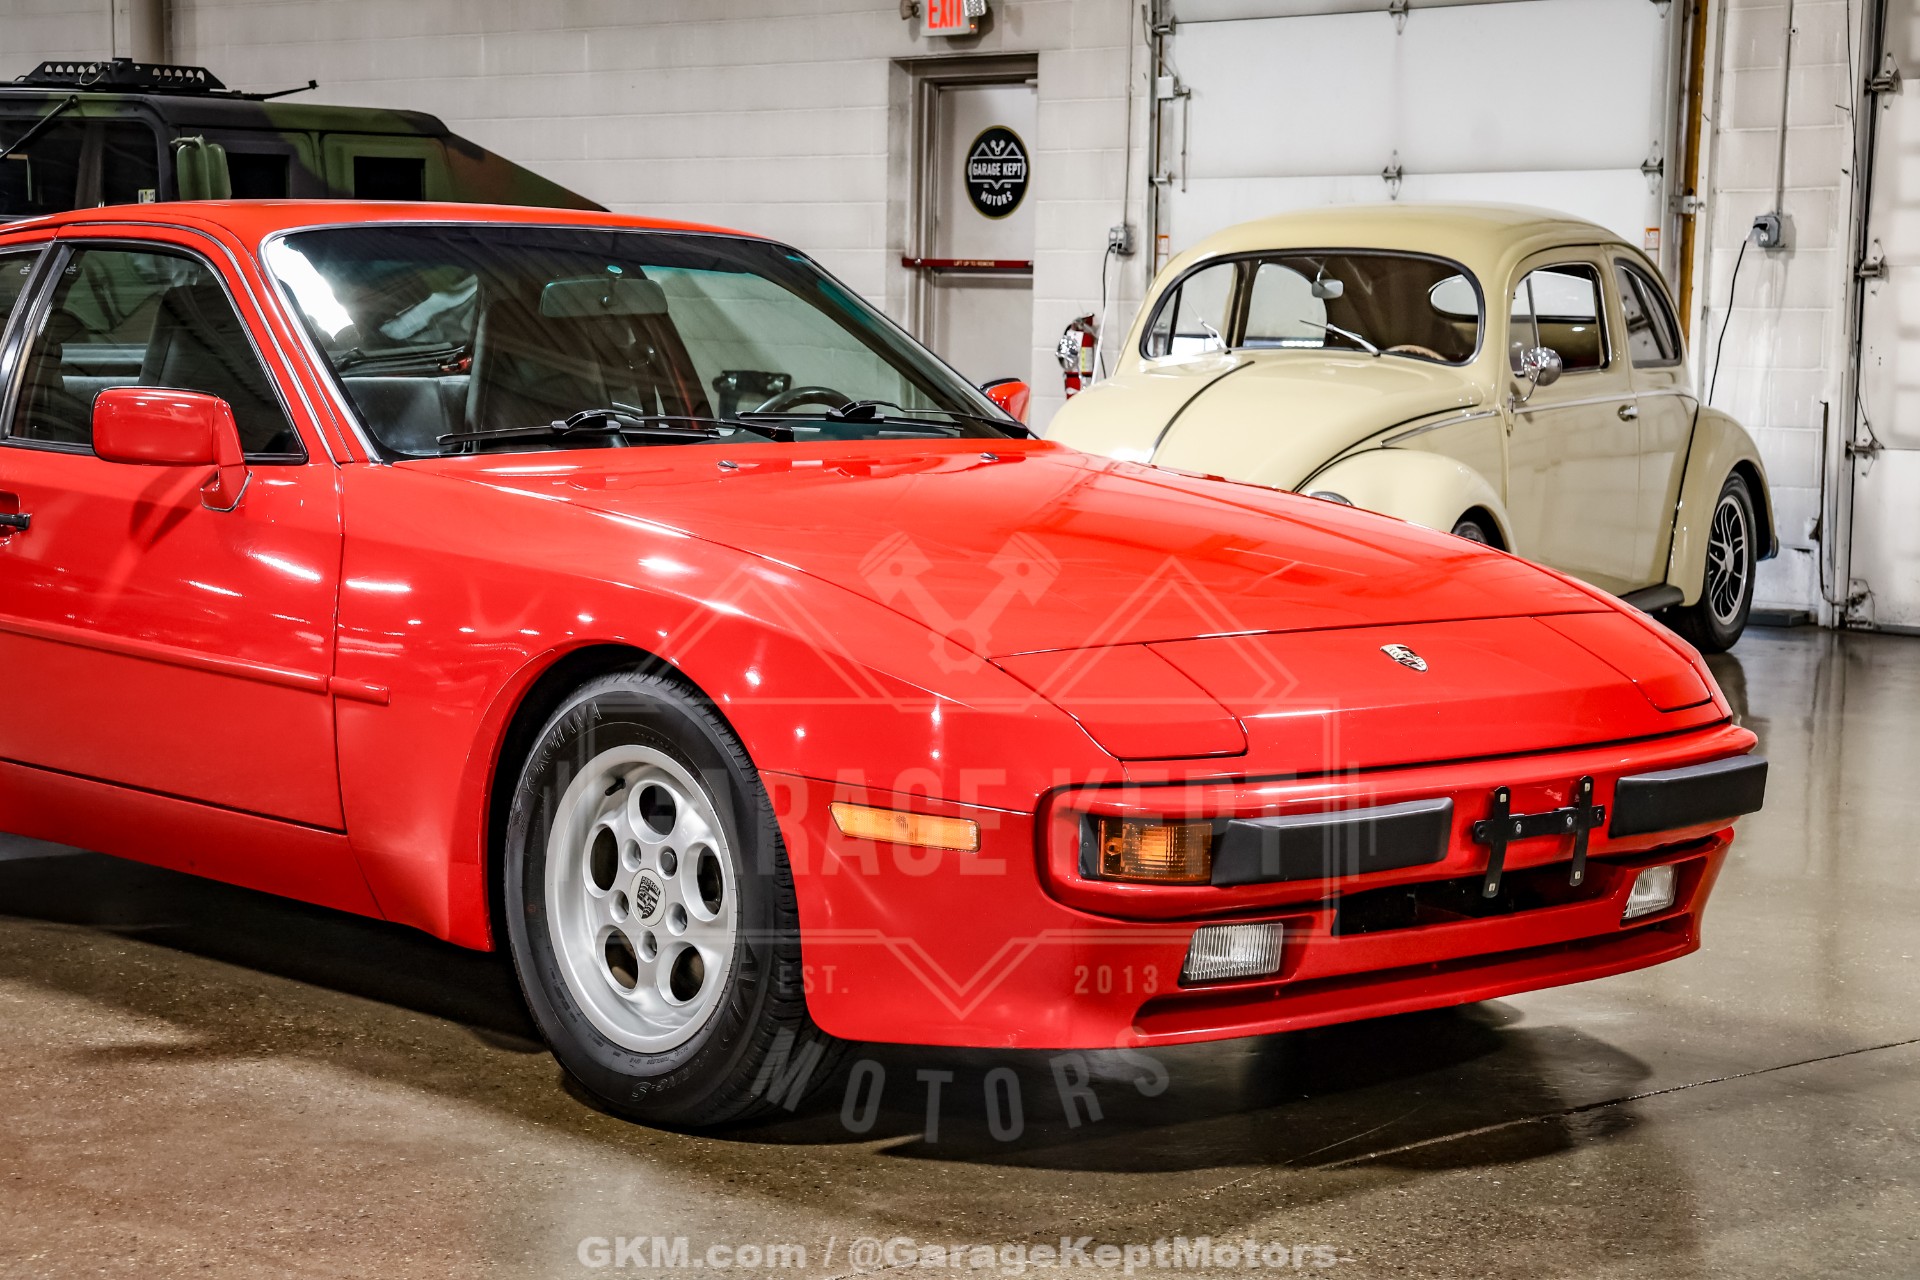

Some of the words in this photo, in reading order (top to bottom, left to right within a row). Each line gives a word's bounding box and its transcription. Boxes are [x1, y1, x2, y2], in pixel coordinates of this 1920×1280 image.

[973, 162, 1001, 176] GARAGE
[1002, 162, 1021, 176] KEPT
[980, 190, 1013, 206] MOTORS
